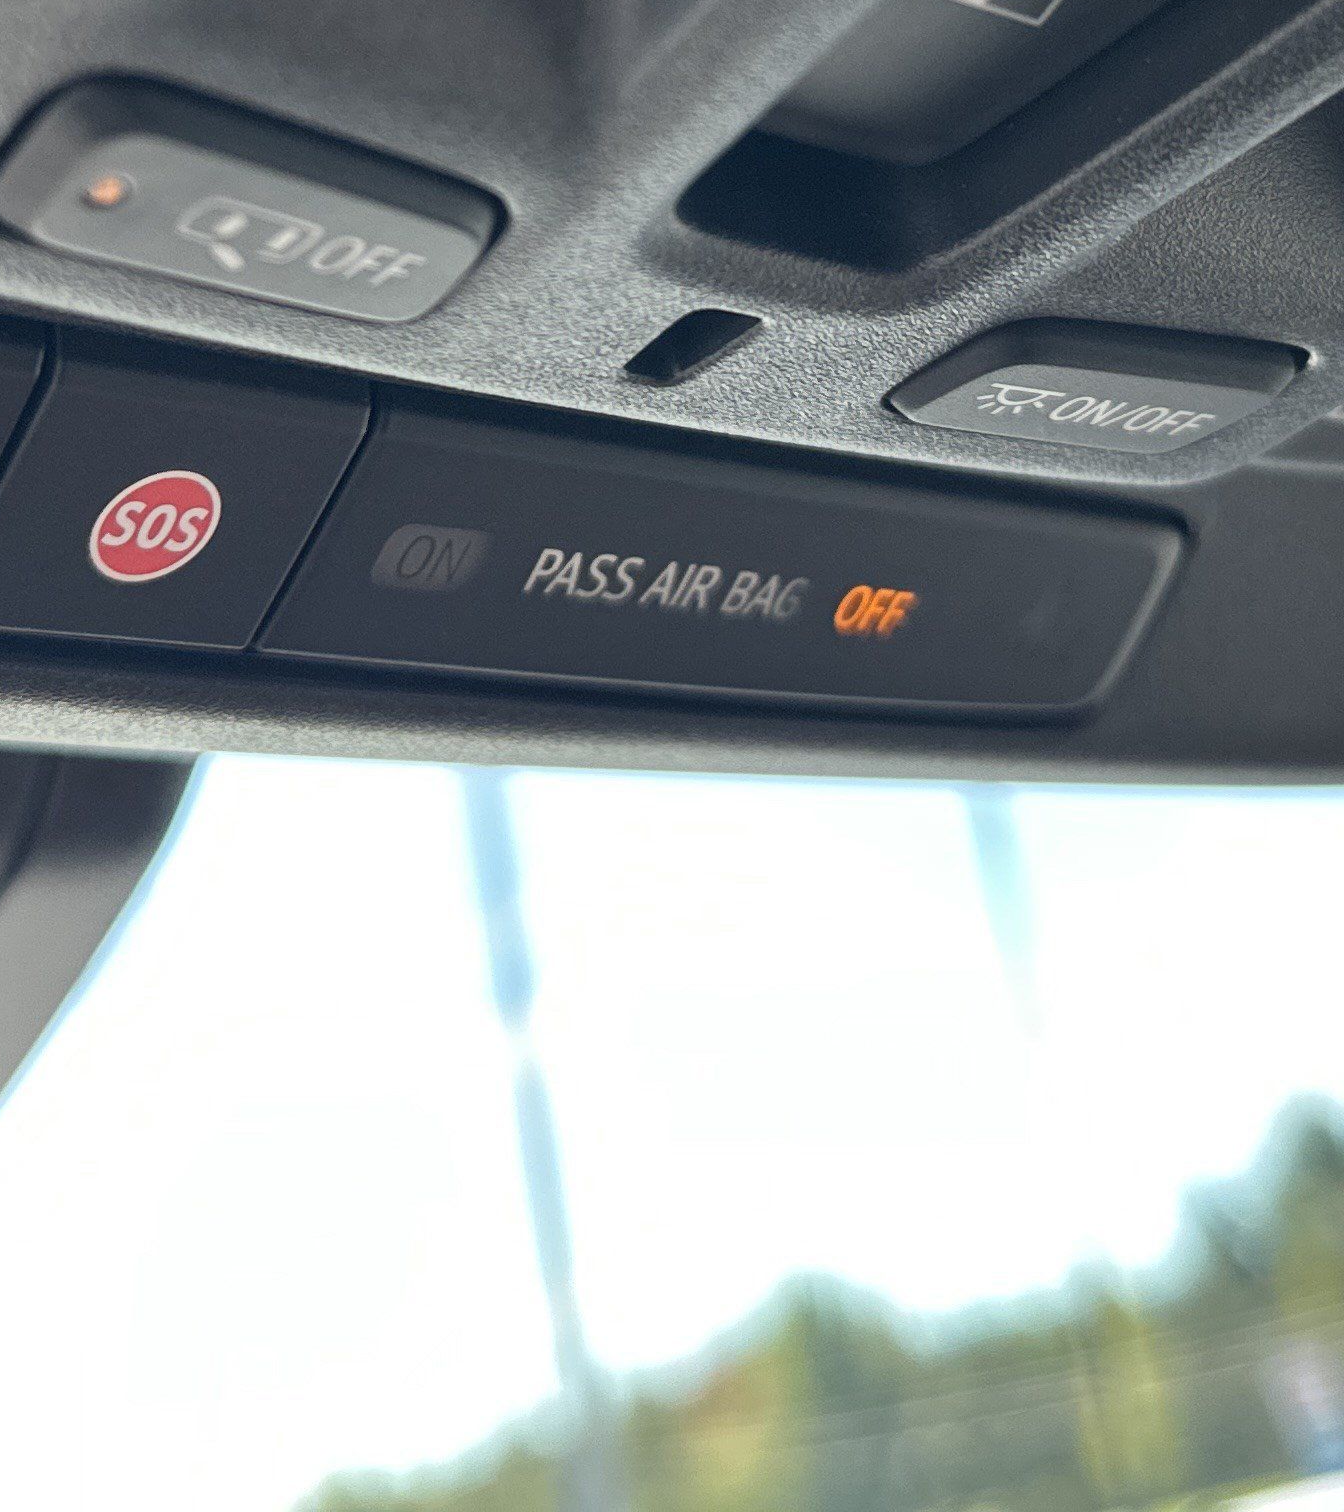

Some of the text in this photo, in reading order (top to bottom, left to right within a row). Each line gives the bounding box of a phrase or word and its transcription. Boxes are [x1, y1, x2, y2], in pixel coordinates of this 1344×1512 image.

[308, 234, 428, 288] OFF
[1049, 395, 1216, 436] ON/OFF
[99, 501, 206, 555] SOS
[393, 532, 472, 582] ON
[522, 547, 810, 621] PASS AIR BAG
[832, 584, 918, 638] OFF
